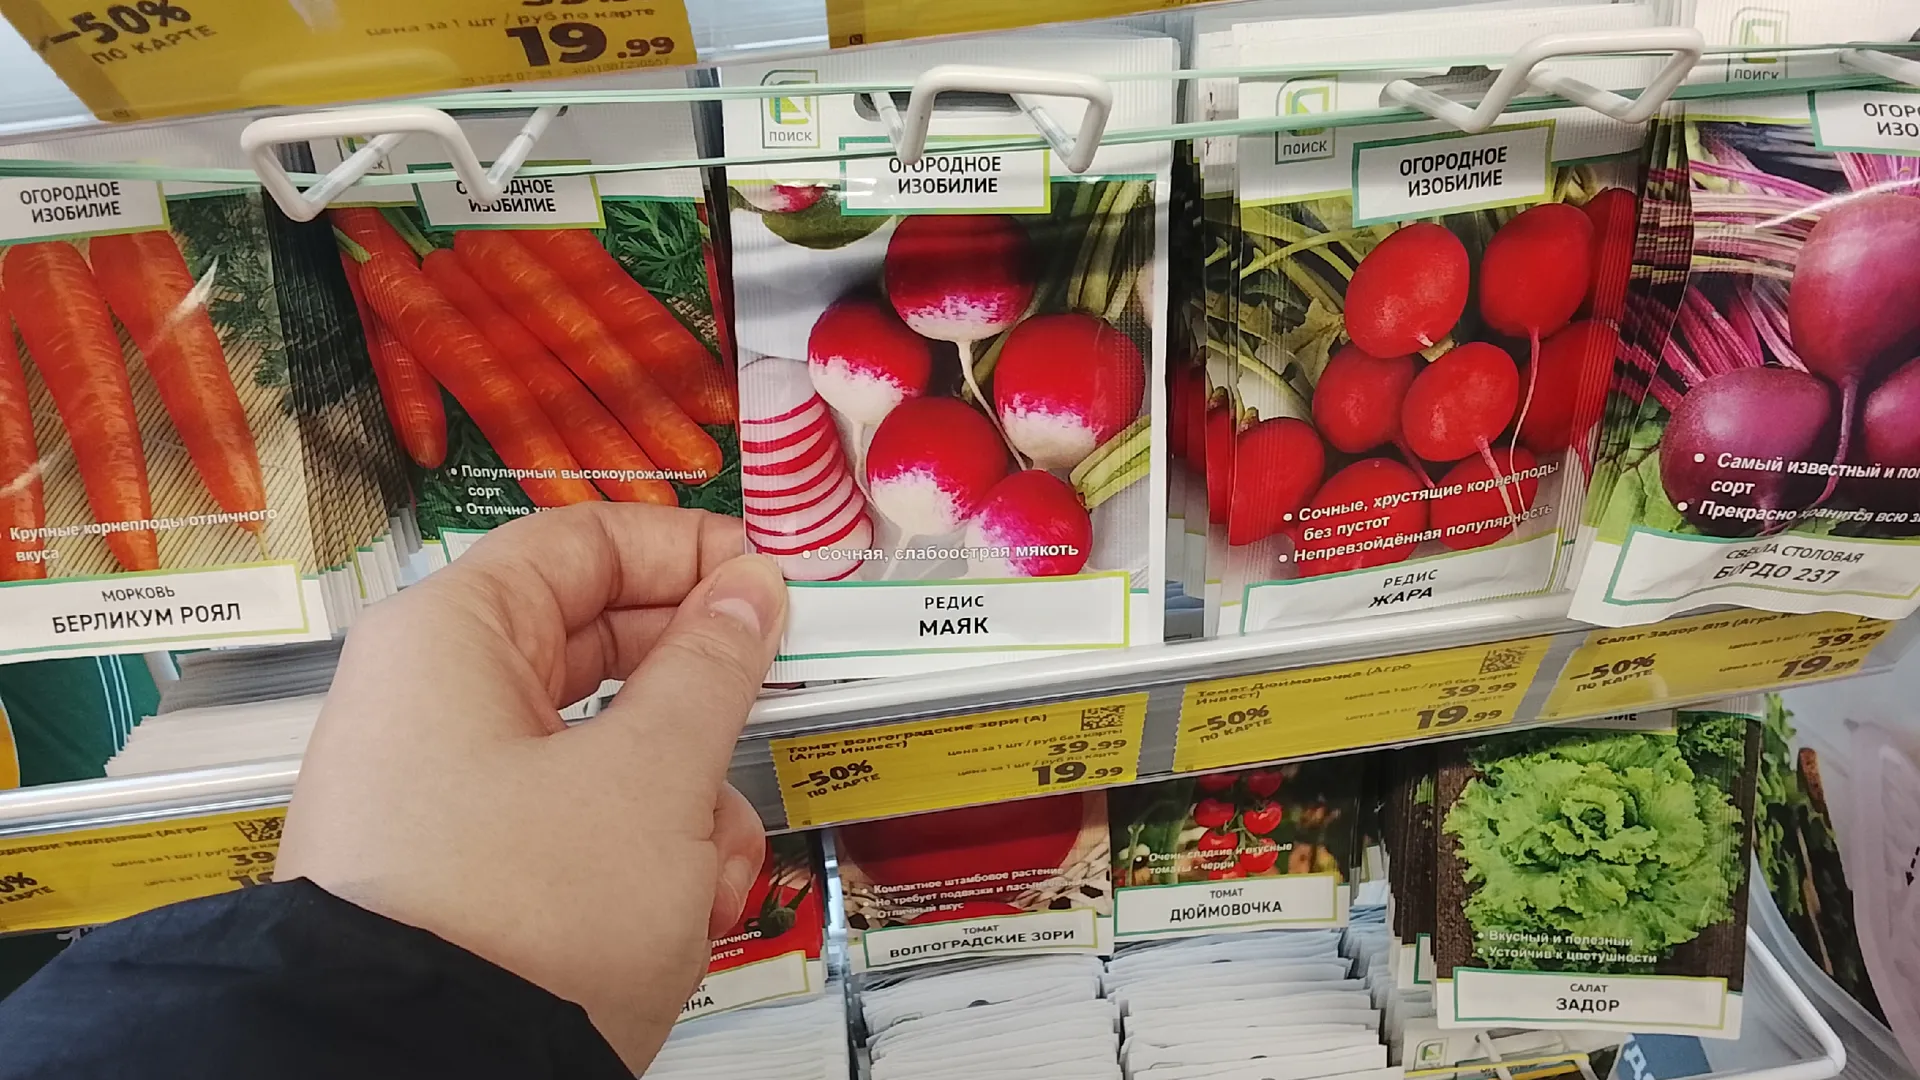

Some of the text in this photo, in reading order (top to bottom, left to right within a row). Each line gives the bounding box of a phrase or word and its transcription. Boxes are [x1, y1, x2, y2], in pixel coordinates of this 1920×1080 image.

[50, 0, 192, 44] -50%
[467, 16, 497, 29] шт
[516, 9, 558, 27] руб
[562, 11, 590, 21] по
[594, 7, 656, 20] карте
[92, 24, 218, 65] ПО КАРТЕ
[505, 21, 675, 67] 19.99
[1734, 68, 1780, 80] ПОИСК
[1863, 102, 1920, 118] ОГОР
[768, 131, 813, 143] ПОИСК
[1877, 121, 1920, 138] ИЗО
[1282, 140, 1328, 157] ПОИСК
[1400, 145, 1508, 177] ОГОРОДНОЕ
[19, 181, 122, 205] ОГОРОДНОЕ
[456, 179, 556, 195] ОДНОЕ
[898, 177, 999, 195] ИЗОБИЛИЕ
[1408, 168, 1503, 198] ИЗОБИЛИЕ
[31, 200, 122, 224] ИЗОБИЛИЕ
[461, 462, 708, 482] Популярный высокоурожайный
[1717, 452, 1920, 480] Самый известный и по
[467, 486, 502, 499] сорт
[1298, 460, 1560, 522] Сочные, хрустящие корнеплоды
[1710, 478, 1756, 497] сорт
[465, 503, 530, 517] Отлично
[1698, 499, 1797, 524] Прекрасно
[1799, 507, 1874, 522] хранится
[1875, 512, 1908, 523] всю
[9, 506, 279, 542] Крупные корнеплоды отличного
[1292, 504, 1554, 563] Непревзойдённая популярность
[1302, 514, 1391, 542] без пустот
[15, 548, 60, 564] вкуса
[817, 544, 1080, 563] Сочная, слабоострая мякоть
[1781, 545, 1865, 564] СТОЛОВАЯ
[1382, 568, 1439, 589] РЕДИС
[1793, 568, 1842, 585] 237
[101, 585, 176, 602] МОРКОВЬ
[924, 595, 985, 611] РЕДИС
[1367, 586, 1434, 609] ЖАРА
[51, 602, 242, 634] БЕРЛИКУМ РОЯЛ
[918, 616, 990, 637] МАЯК
[1596, 633, 1645, 645] Салат
[1647, 625, 1699, 640] Задор
[1732, 614, 1779, 630] (Агро
[1810, 630, 1885, 650] 39.99
[1569, 652, 1657, 681] -50%
[1777, 655, 1860, 679] 19.99
[1196, 686, 1248, 698] Томат
[1250, 671, 1362, 692] Дюймовочка
[1366, 663, 1413, 677] (Агро
[1575, 668, 1654, 692] ПО КАРТЕ
[1195, 691, 1261, 706] Инвест)
[1437, 682, 1518, 699] 39.99
[1188, 704, 1270, 733] -50%
[1416, 705, 1503, 730] 19.99
[786, 714, 1048, 754] Томат Волгоградские зори (А)
[1199, 717, 1273, 743] ПО КАРТЕ
[788, 740, 909, 763] (Агро Инвест)
[1033, 736, 1058, 747] руб
[1048, 739, 1128, 757] 39.99
[791, 759, 874, 789] -50%
[1032, 761, 1124, 787] 19.99
[806, 773, 882, 799] ПО КАРТЕ
[155, 825, 208, 838] (Агро
[1186, 848, 1234, 859] сладкие
[1245, 842, 1293, 857] вкусные
[1200, 860, 1235, 872] черри
[873, 866, 1064, 895] Компактное штамбовое растение
[875, 897, 891, 908] Не
[893, 892, 938, 908] требует
[939, 886, 994, 901] подвязки
[996, 883, 1005, 893] и
[1209, 888, 1244, 899] ТОМАТ
[876, 901, 965, 919] Отличный вкус
[1169, 900, 1283, 924] ДЮЙМОВОЧКА
[711, 930, 762, 949] личного
[962, 924, 1000, 936] ТОМАТ
[1488, 930, 1634, 946] Вкусный и полезный
[710, 947, 744, 962] нятся
[889, 930, 1076, 959] ВОЛГОГРАДСКИЕ ЗОРИ
[1488, 945, 1658, 964] Устойчив к цветушности
[1569, 983, 1609, 993] САЛАТ
[680, 996, 714, 1014] ЯНА
[1556, 997, 1621, 1014] ЗАДОР
